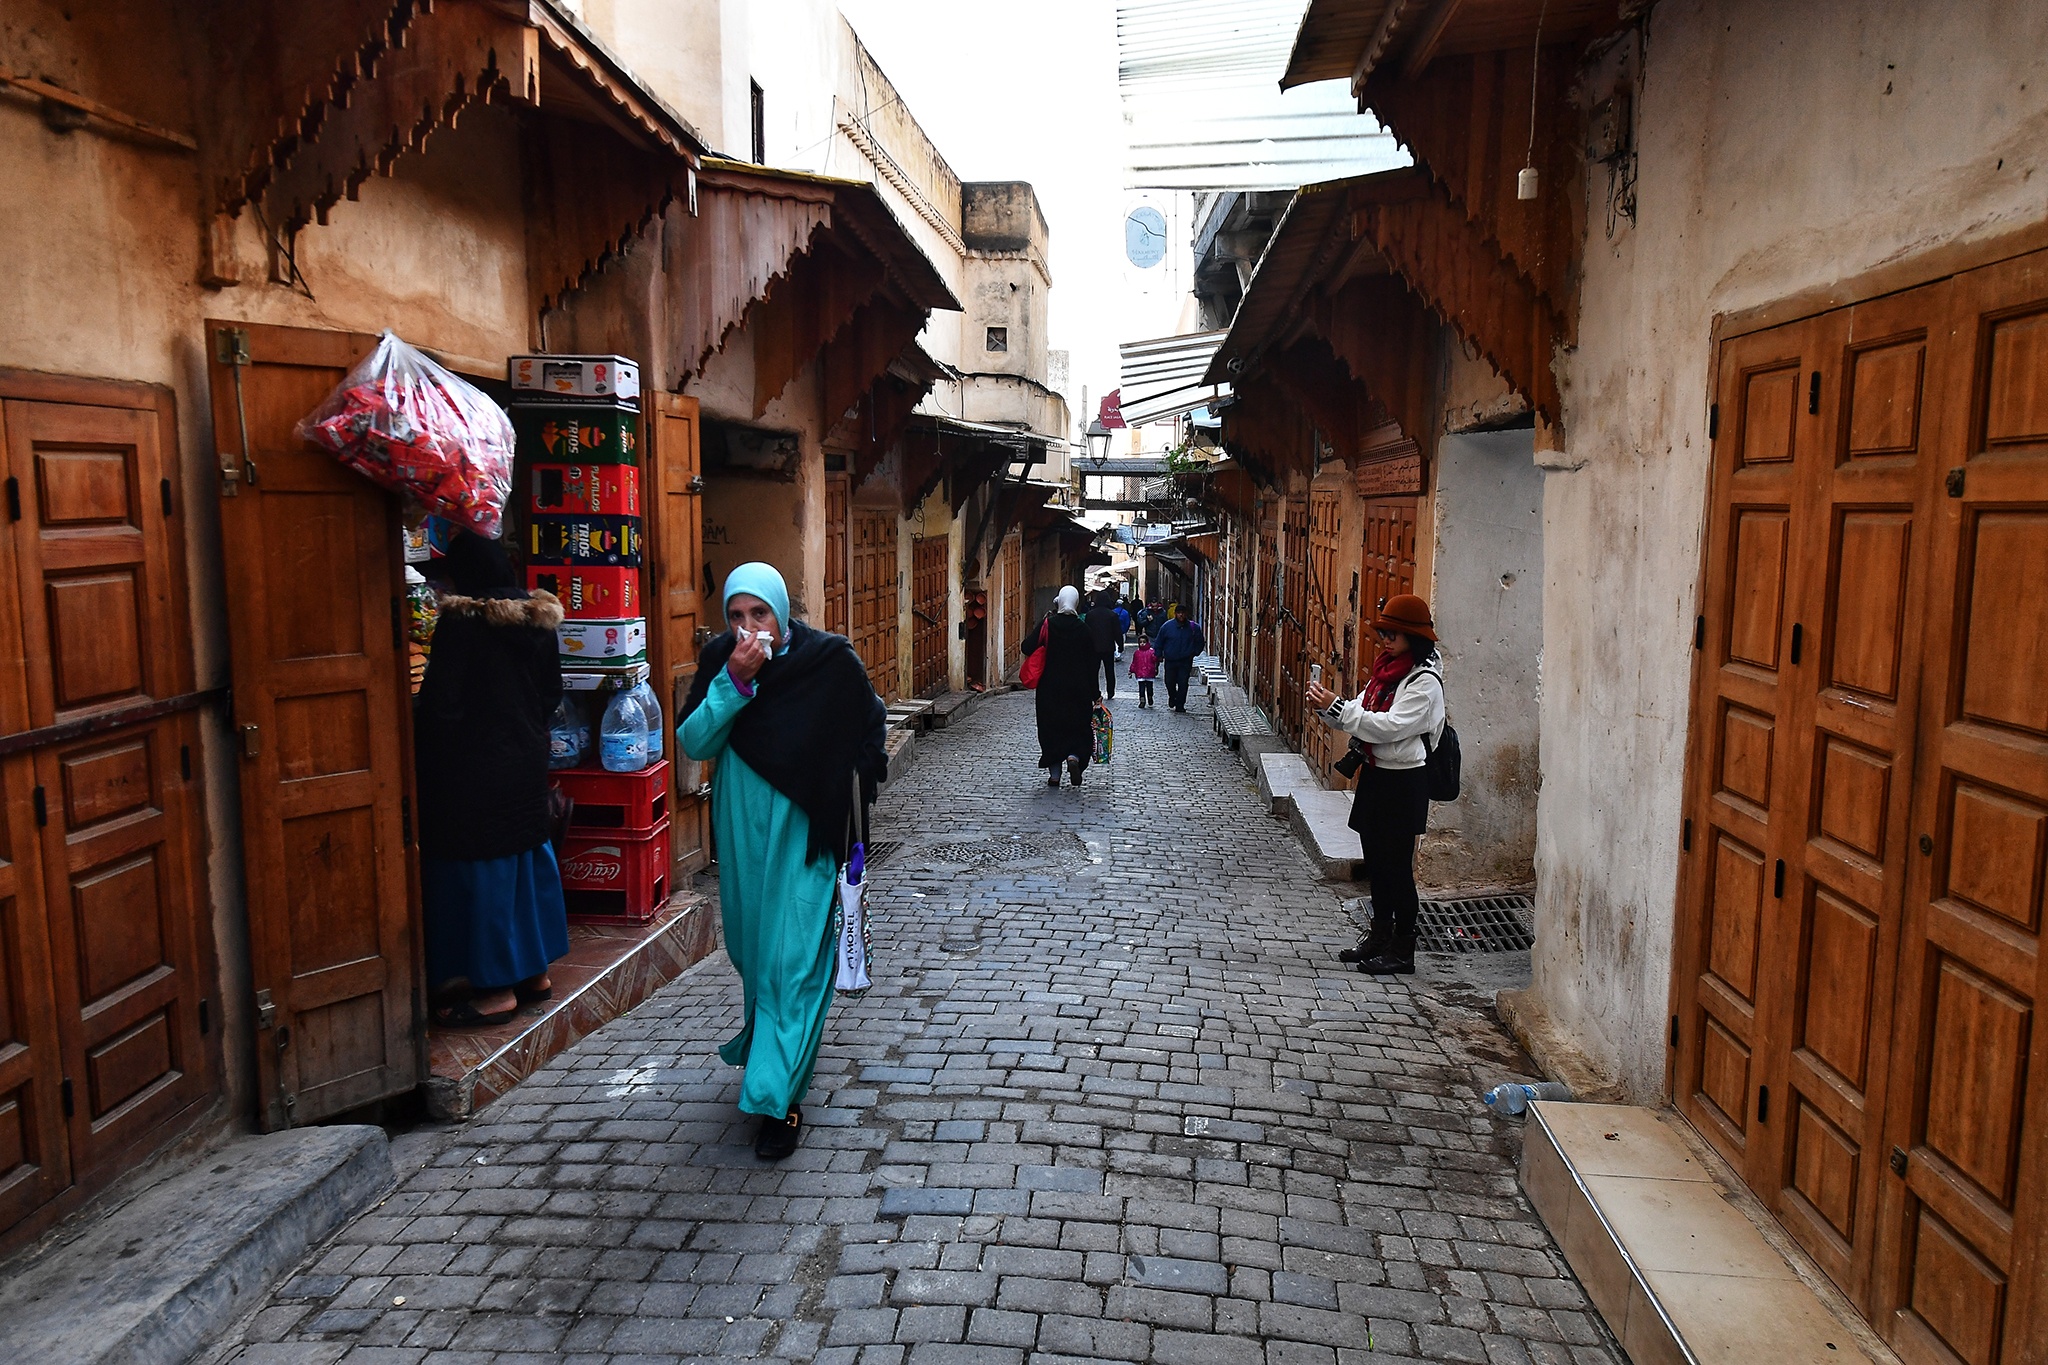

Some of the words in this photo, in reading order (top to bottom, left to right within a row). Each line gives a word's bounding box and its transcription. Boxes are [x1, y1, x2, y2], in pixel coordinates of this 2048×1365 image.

[567, 419, 580, 454] TRIOS
[591, 465, 601, 512] PLATILLOS
[578, 522, 591, 558] TRIOS
[571, 576, 583, 611] TRIOS
[846, 911, 855, 955] MOREL
